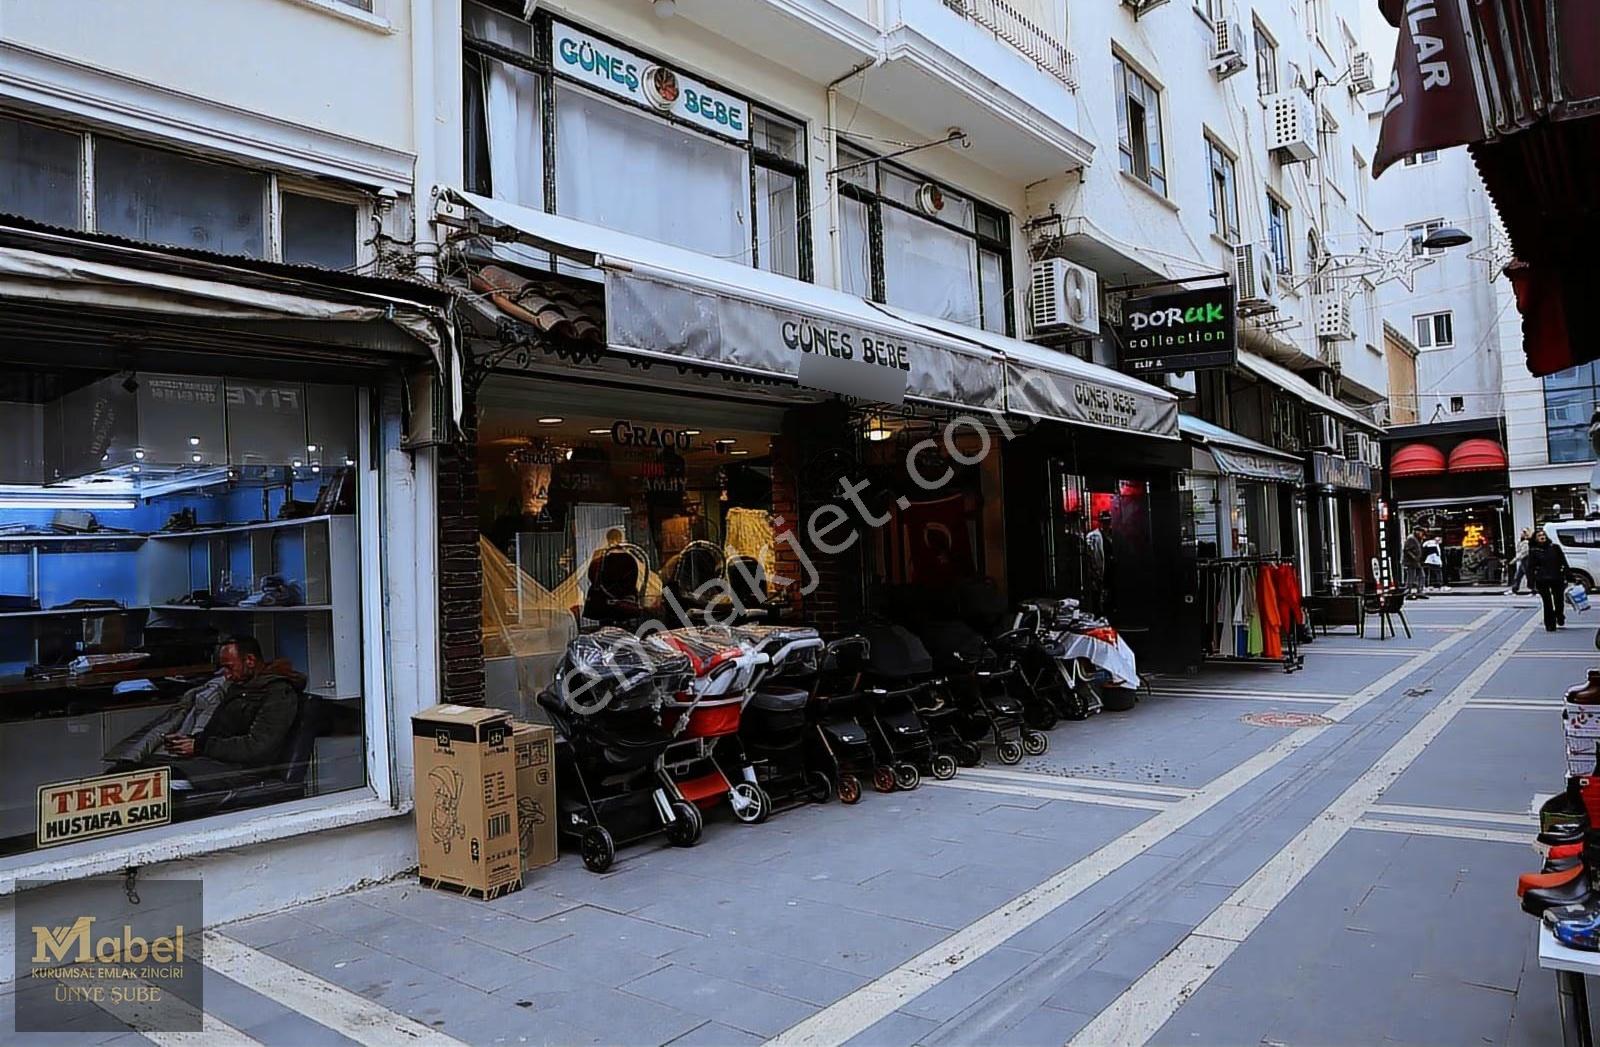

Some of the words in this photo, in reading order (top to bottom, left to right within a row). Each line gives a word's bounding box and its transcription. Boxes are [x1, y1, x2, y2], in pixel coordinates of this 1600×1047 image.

[559, 38, 639, 92] GÜNEŞ
[684, 89, 743, 131] BEBE
[862, 337, 911, 372] BEBE
[1129, 330, 1225, 349] collection
[1112, 392, 1137, 416] BEBE
[611, 418, 691, 449] GRACO
[51, 772, 162, 815] TERZİ
[127, 802, 167, 824] SARI
